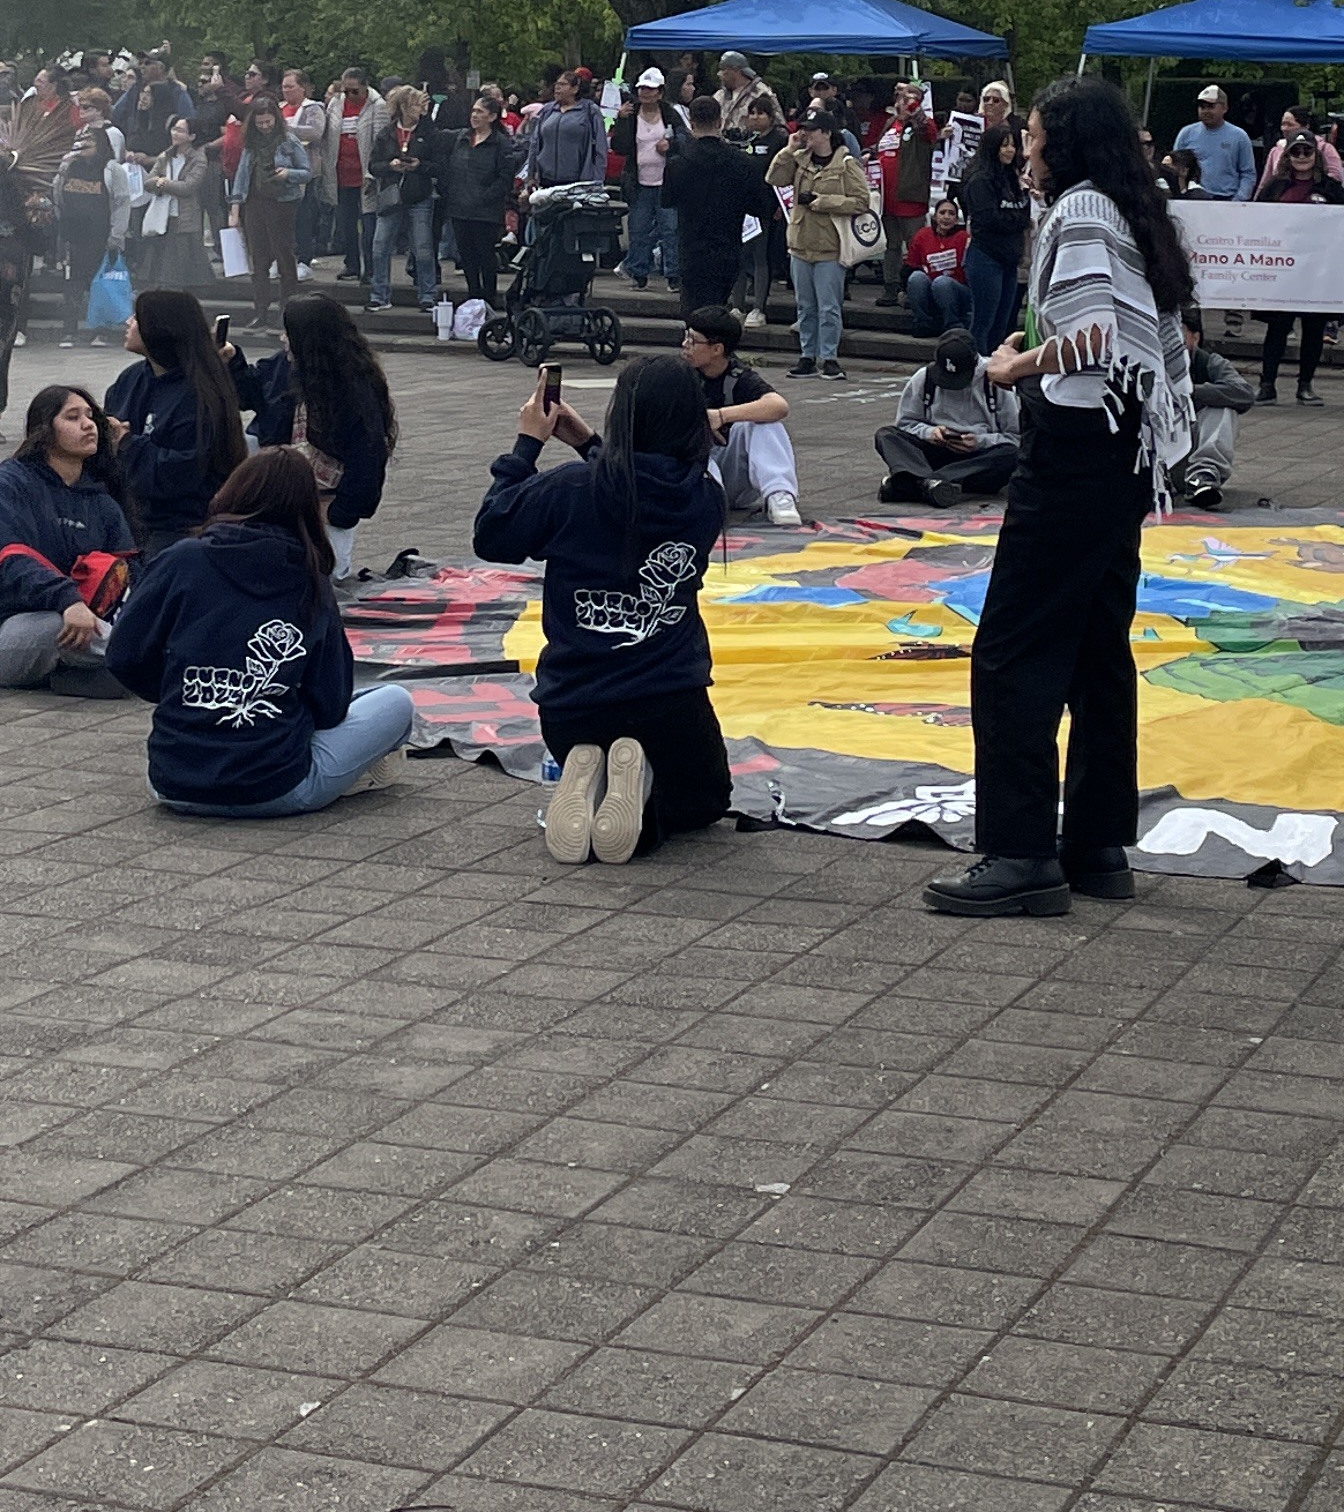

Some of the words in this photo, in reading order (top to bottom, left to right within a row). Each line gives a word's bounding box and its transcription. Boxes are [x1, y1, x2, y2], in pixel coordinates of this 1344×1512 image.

[1197, 234, 1234, 246] Centro
[1237, 235, 1282, 248] Familiar
[1233, 253, 1245, 265] A
[1250, 253, 1295, 267] Mano
[1200, 270, 1238, 284] Family
[1241, 271, 1278, 282] Center
